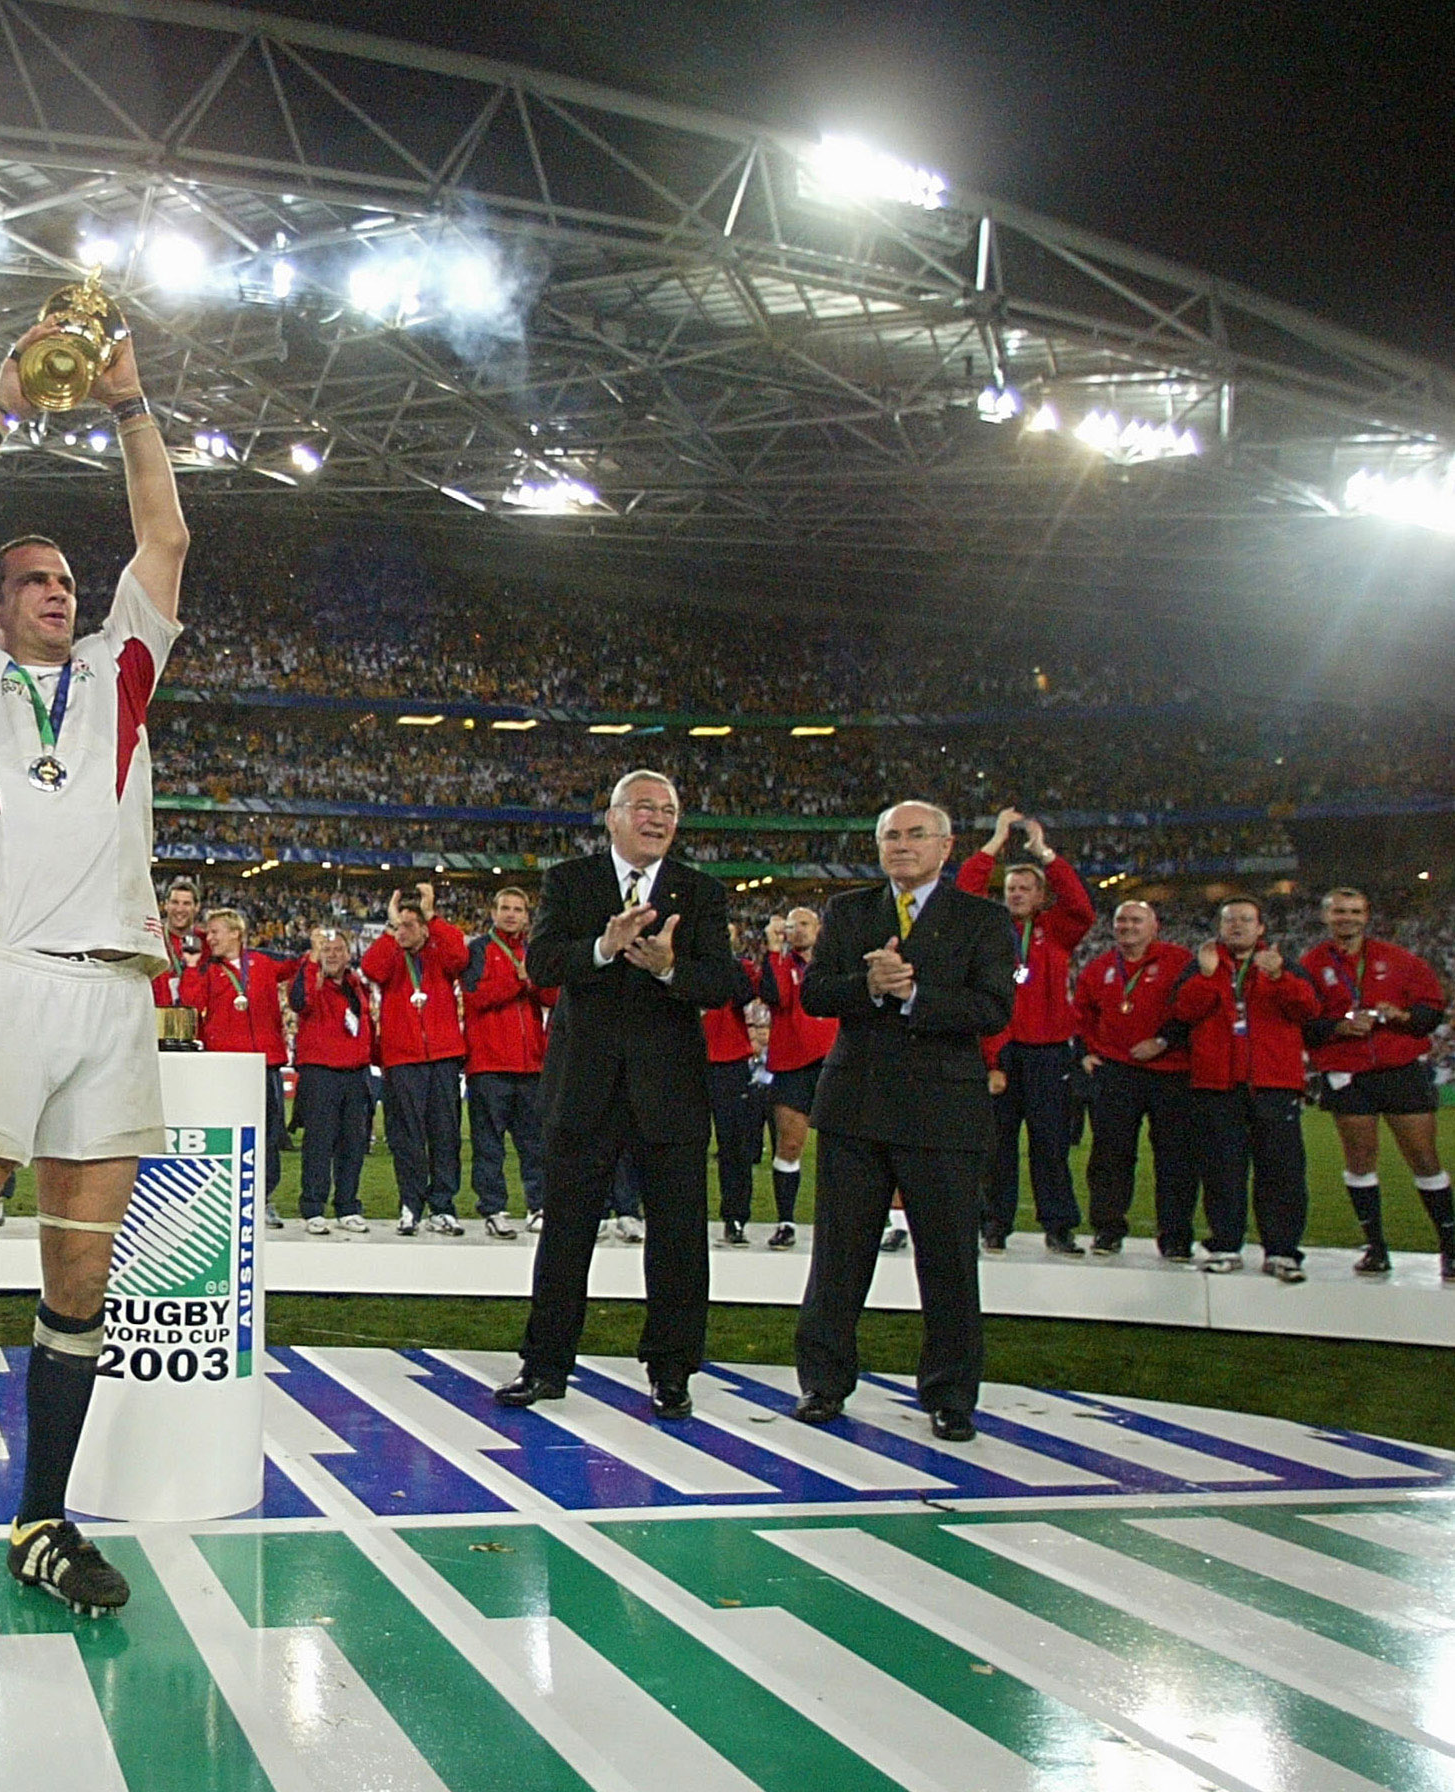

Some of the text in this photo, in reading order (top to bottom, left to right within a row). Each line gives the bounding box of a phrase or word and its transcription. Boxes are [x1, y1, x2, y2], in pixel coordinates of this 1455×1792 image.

[165, 1129, 207, 1154] RB
[239, 1148, 255, 1328] AUSTRALIA
[104, 1298, 230, 1327] RUGBY
[188, 1327, 231, 1344] CUP
[95, 1343, 230, 1383] 2003
